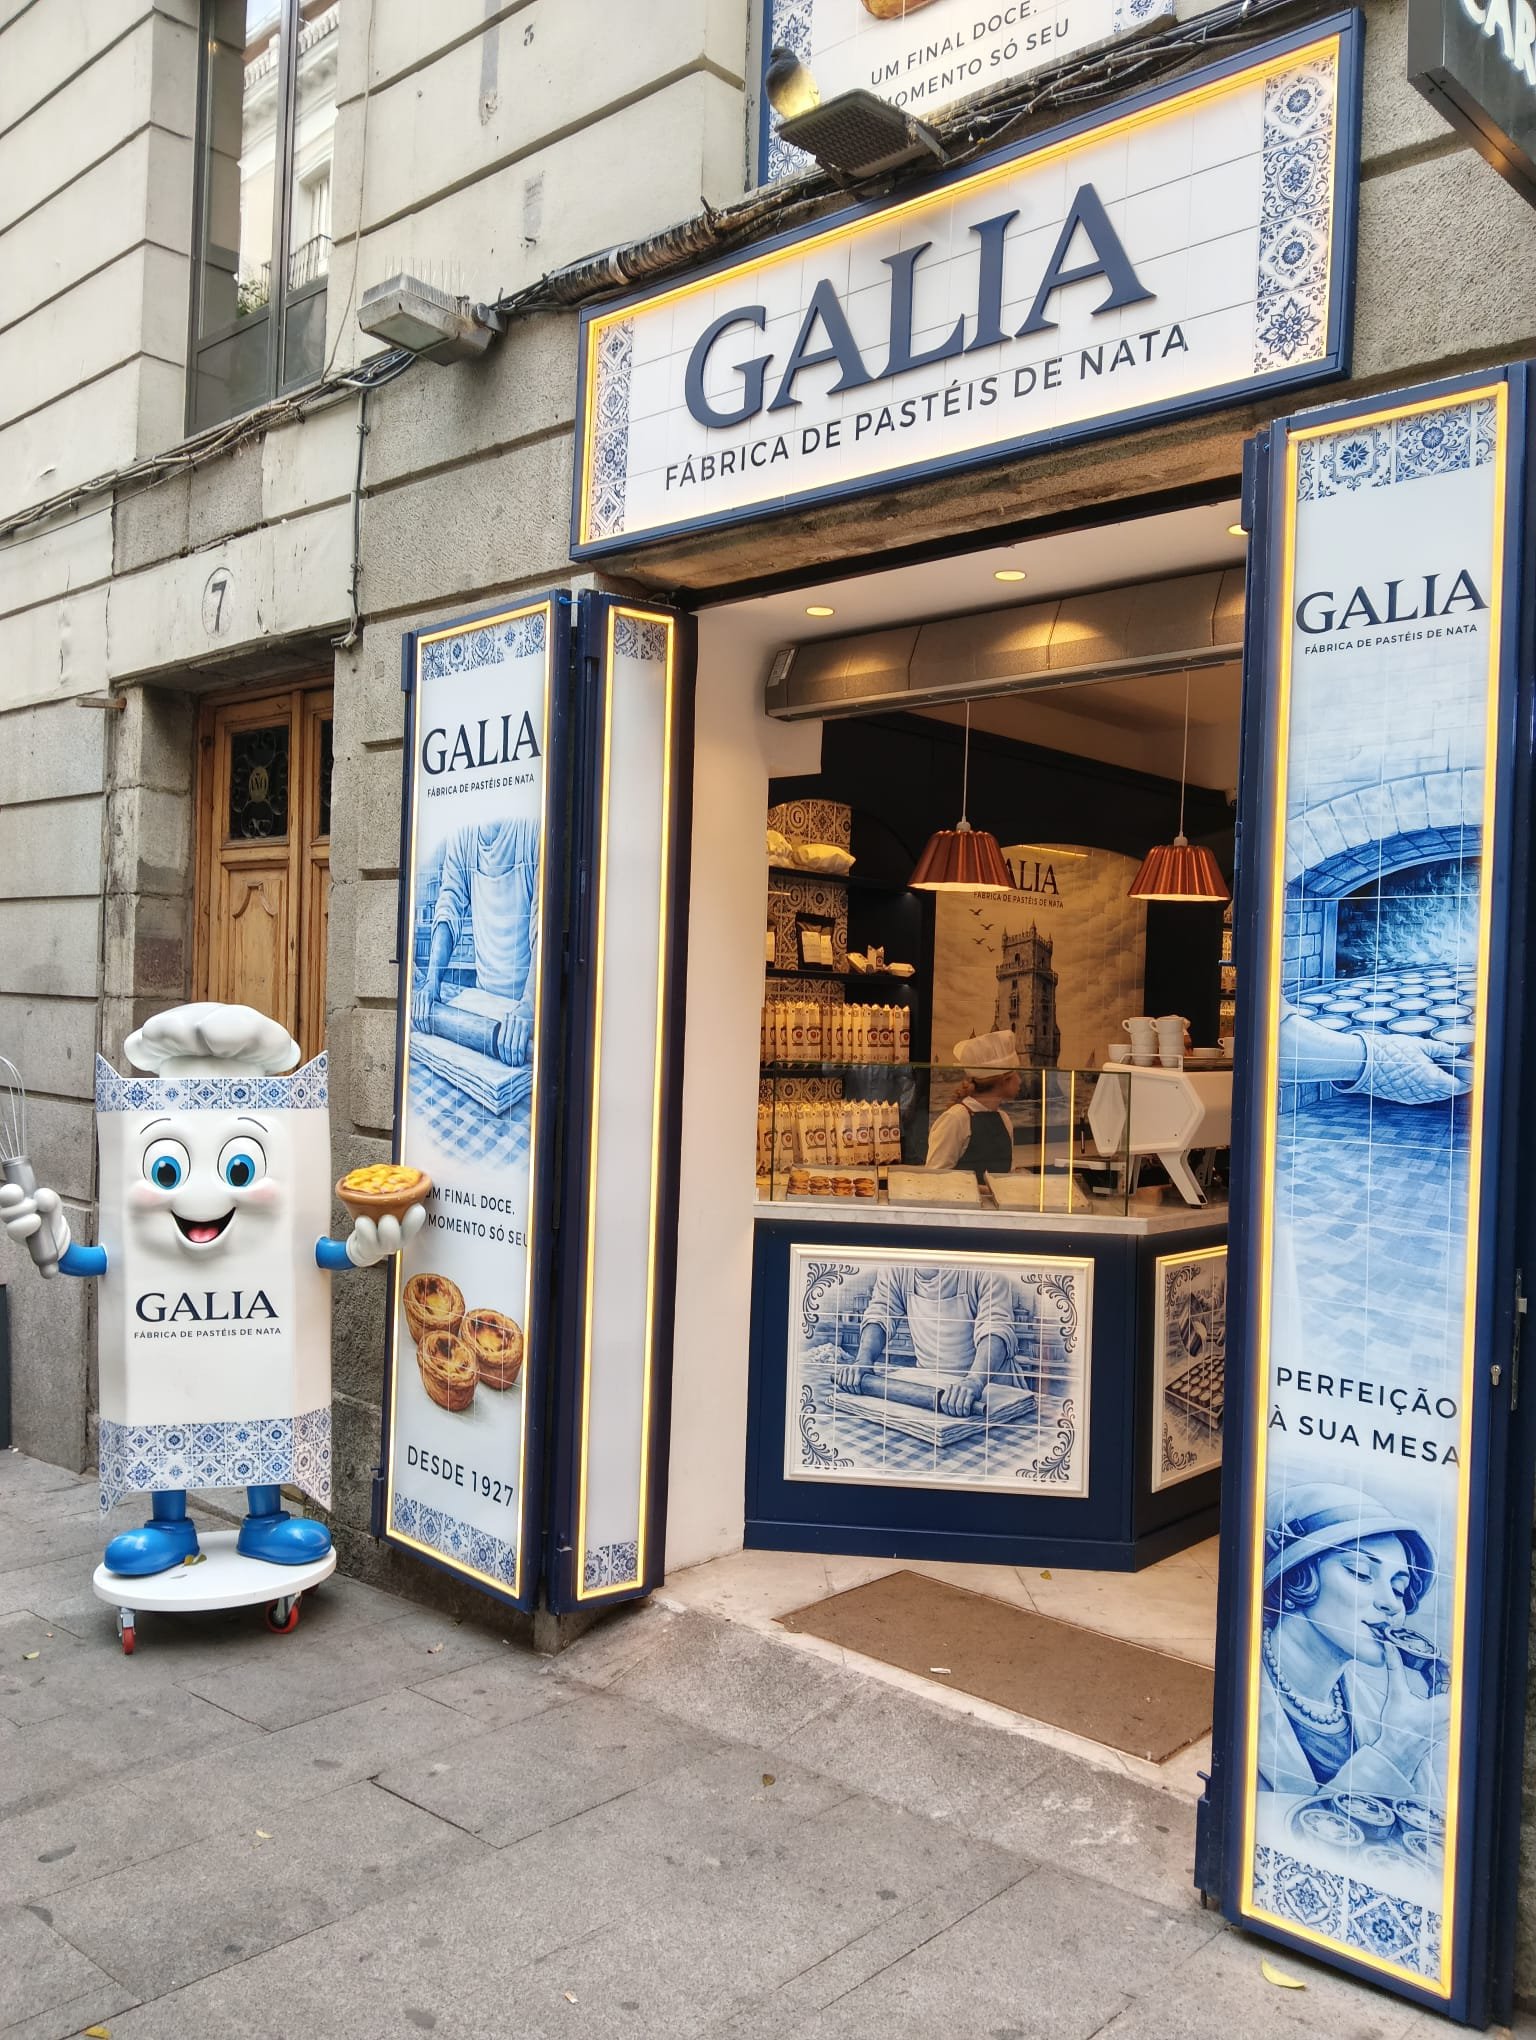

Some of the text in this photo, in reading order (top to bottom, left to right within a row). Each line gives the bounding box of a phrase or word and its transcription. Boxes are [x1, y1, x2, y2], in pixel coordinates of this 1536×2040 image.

[871, 0, 1037, 85] UM FINAL DOCE.
[990, 38, 1018, 66] SÓ
[1026, 18, 1069, 51] SEU
[685, 182, 1158, 429] GALIA
[665, 324, 1189, 491] FÁBRICA DE PASTÉIS DE NATA
[211, 580, 227, 633] 7
[1295, 568, 1490, 635] GALIA
[1304, 624, 1478, 655] FÁBRICA DE PASTÉIS DE NATA
[422, 710, 541, 775] GALIA
[427, 773, 535, 798] FÁBRICA DE PASTÉIS DE NATA
[1002, 894, 1012, 903] DE
[1039, 898, 1047, 907] DE
[1005, 857, 1060, 895] ALIA
[444, 1188, 477, 1208] FINAL
[480, 1195, 515, 1216] DOCE.
[428, 1213, 486, 1238] MOMENTO
[489, 1224, 505, 1242] SÓ
[135, 1289, 280, 1323] GALIA
[134, 1327, 282, 1339] FÁBRICA DE PASTÉIS DE NATA
[1276, 1366, 1458, 1419] PERFEIÇÃO
[1268, 1404, 1460, 1468] À SUA MESA
[407, 1445, 514, 1508] DESDE 1927
